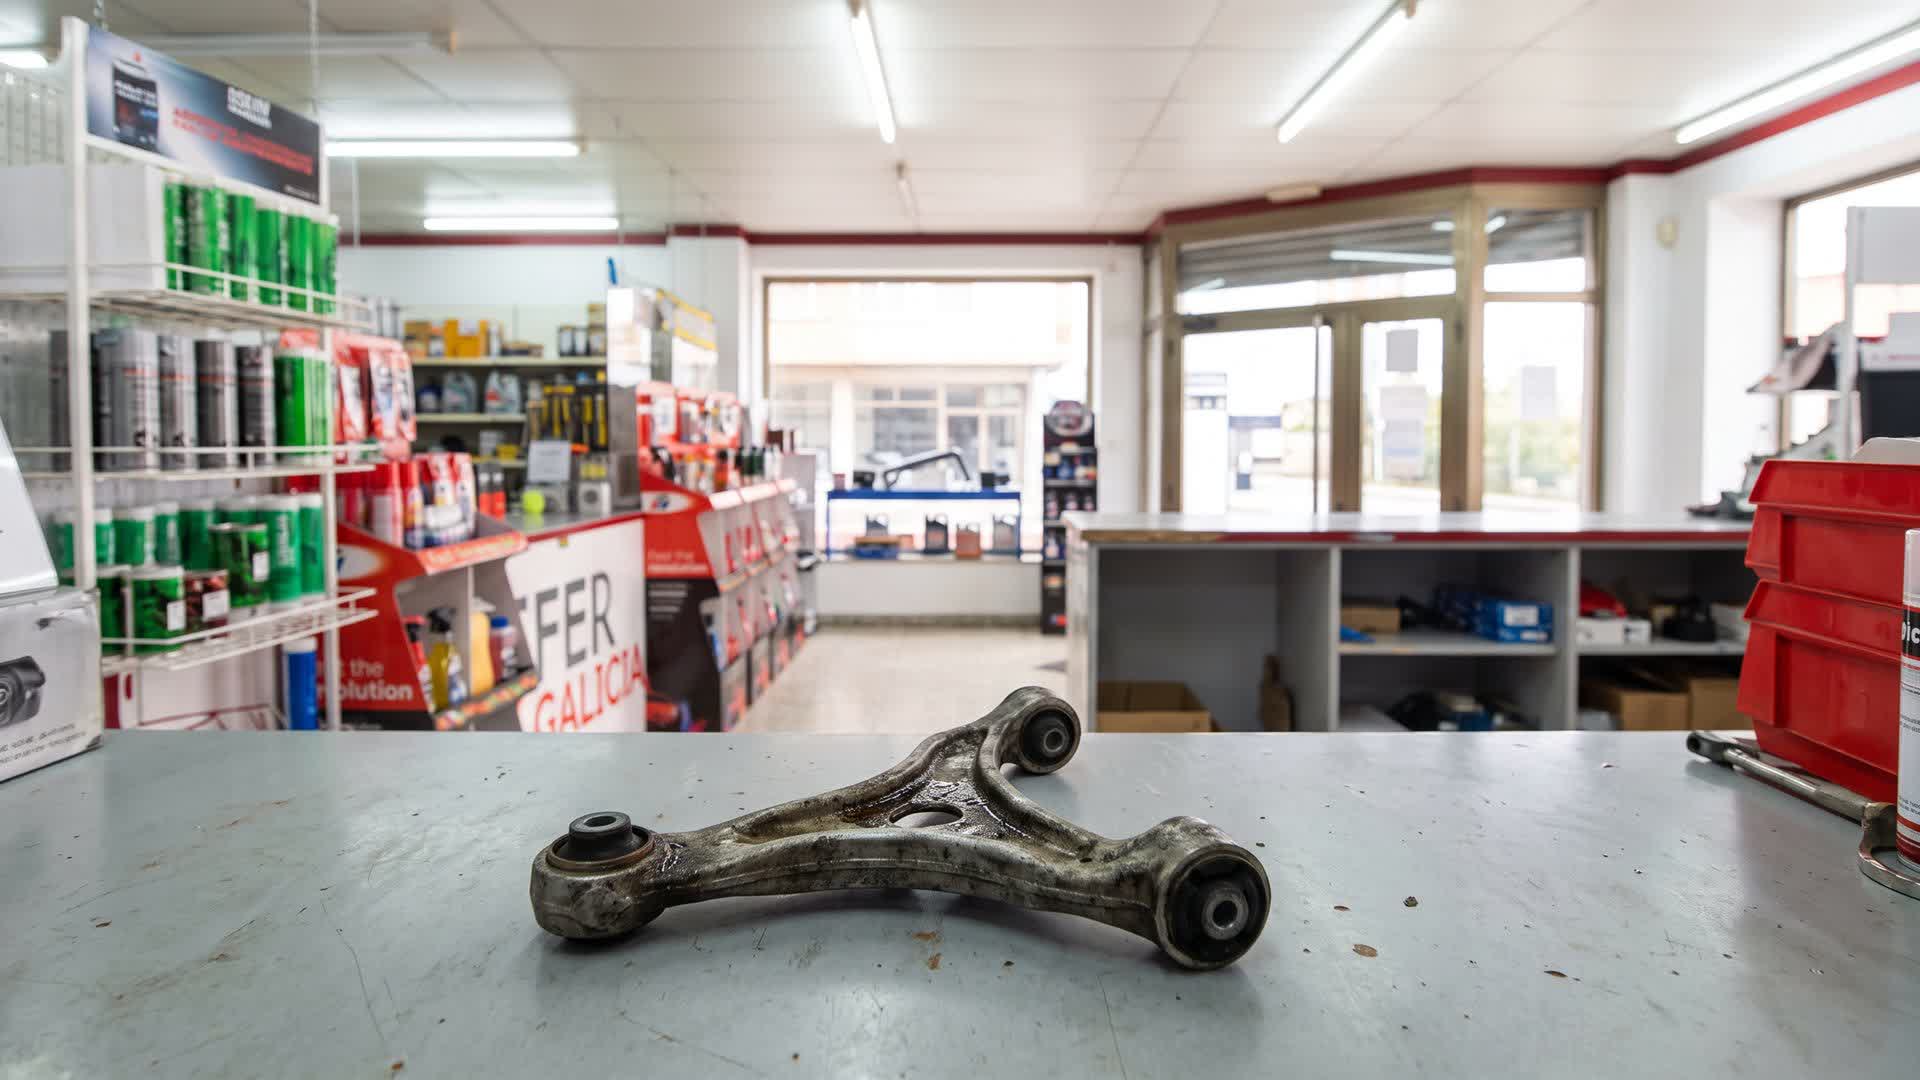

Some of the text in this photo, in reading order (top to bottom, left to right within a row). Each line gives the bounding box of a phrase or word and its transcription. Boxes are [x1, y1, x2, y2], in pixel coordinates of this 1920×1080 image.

[517, 572, 616, 678] FER
[318, 680, 413, 701] olution
[534, 642, 651, 732] GALICIA
